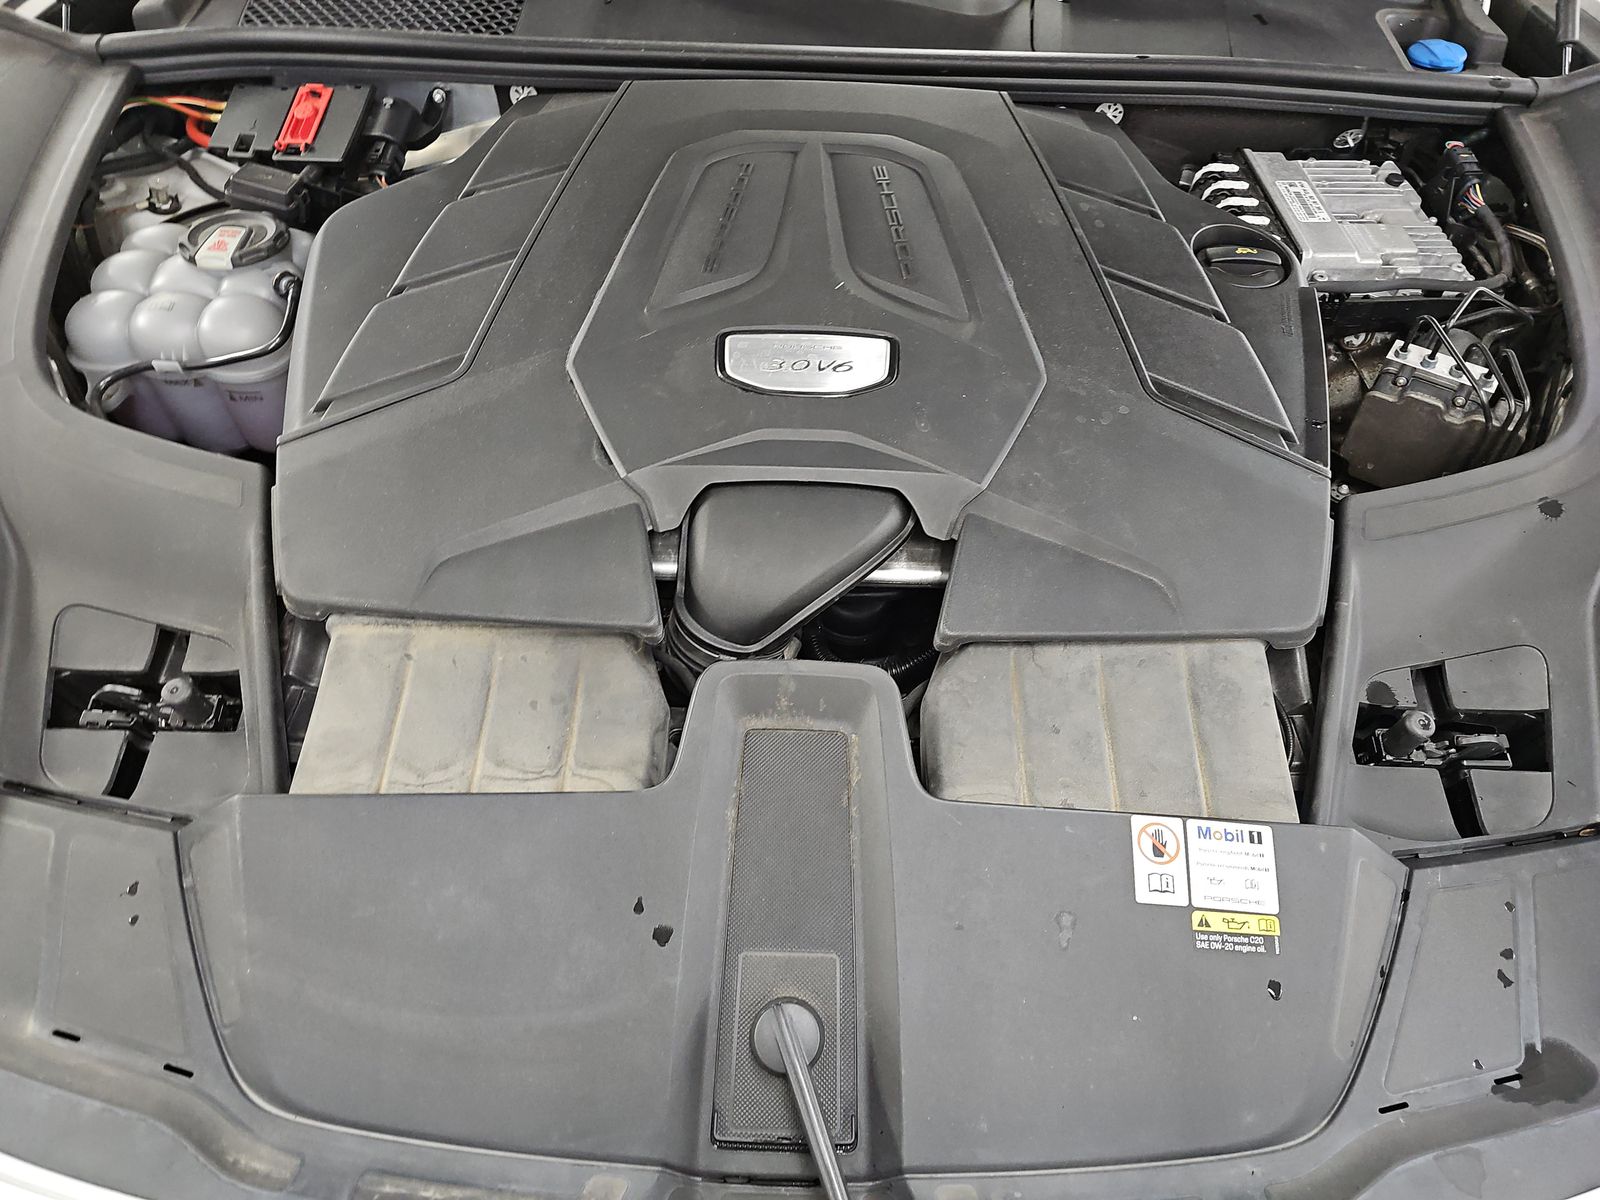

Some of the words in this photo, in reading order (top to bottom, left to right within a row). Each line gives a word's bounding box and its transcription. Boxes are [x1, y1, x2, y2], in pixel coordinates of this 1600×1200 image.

[872, 165, 912, 280] PORSCHE
[818, 359, 853, 373] V6
[1197, 826, 1244, 843] Mobil
[1248, 830, 1263, 845] 1
[1203, 895, 1266, 906] PORSCHE
[1195, 932, 1209, 941] Use
[1209, 934, 1222, 943] only
[1223, 934, 1249, 944] Porsche
[1249, 936, 1264, 945] C20
[1196, 941, 1210, 949] SAE
[1210, 942, 1234, 951] 0W-20
[1234, 945, 1256, 953] engine
